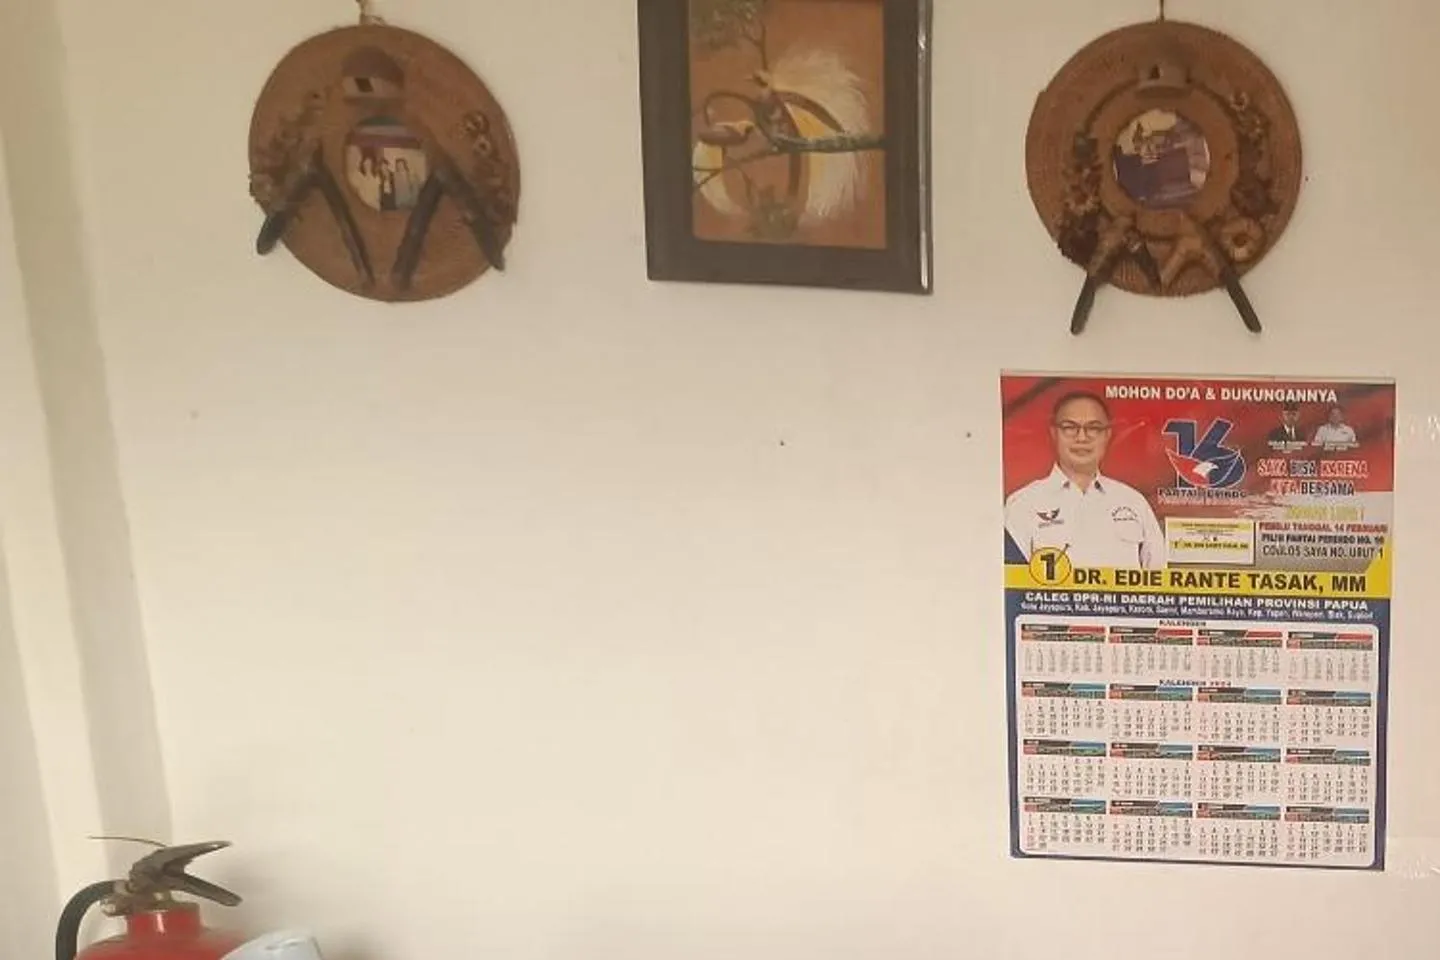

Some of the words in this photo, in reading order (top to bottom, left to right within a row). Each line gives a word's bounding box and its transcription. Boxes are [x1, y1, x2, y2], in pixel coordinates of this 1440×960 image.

[1105, 385, 1161, 399] MOHON
[1165, 387, 1200, 400] DO'A
[1205, 389, 1216, 400] &
[1221, 388, 1337, 403] DUKUNGANNYA
[1300, 480, 1355, 496] BERSAMA
[1304, 546, 1329, 557] SAYA
[1349, 548, 1374, 558] URUT
[1040, 553, 1055, 580] 1
[1074, 568, 1107, 585] DR.
[1114, 570, 1162, 587] EDIE
[1170, 571, 1240, 588] RANTE
[1248, 573, 1324, 593] TASAK,
[1331, 575, 1366, 592] MM
[1025, 592, 1071, 602] CALEG
[1073, 593, 1117, 603] DPR-RI
[1120, 594, 1175, 605] DAERAH
[1178, 596, 1253, 608] PEMILIHAN
[1257, 598, 1321, 609] PROVINSI
[1324, 600, 1369, 611] PAPUA
